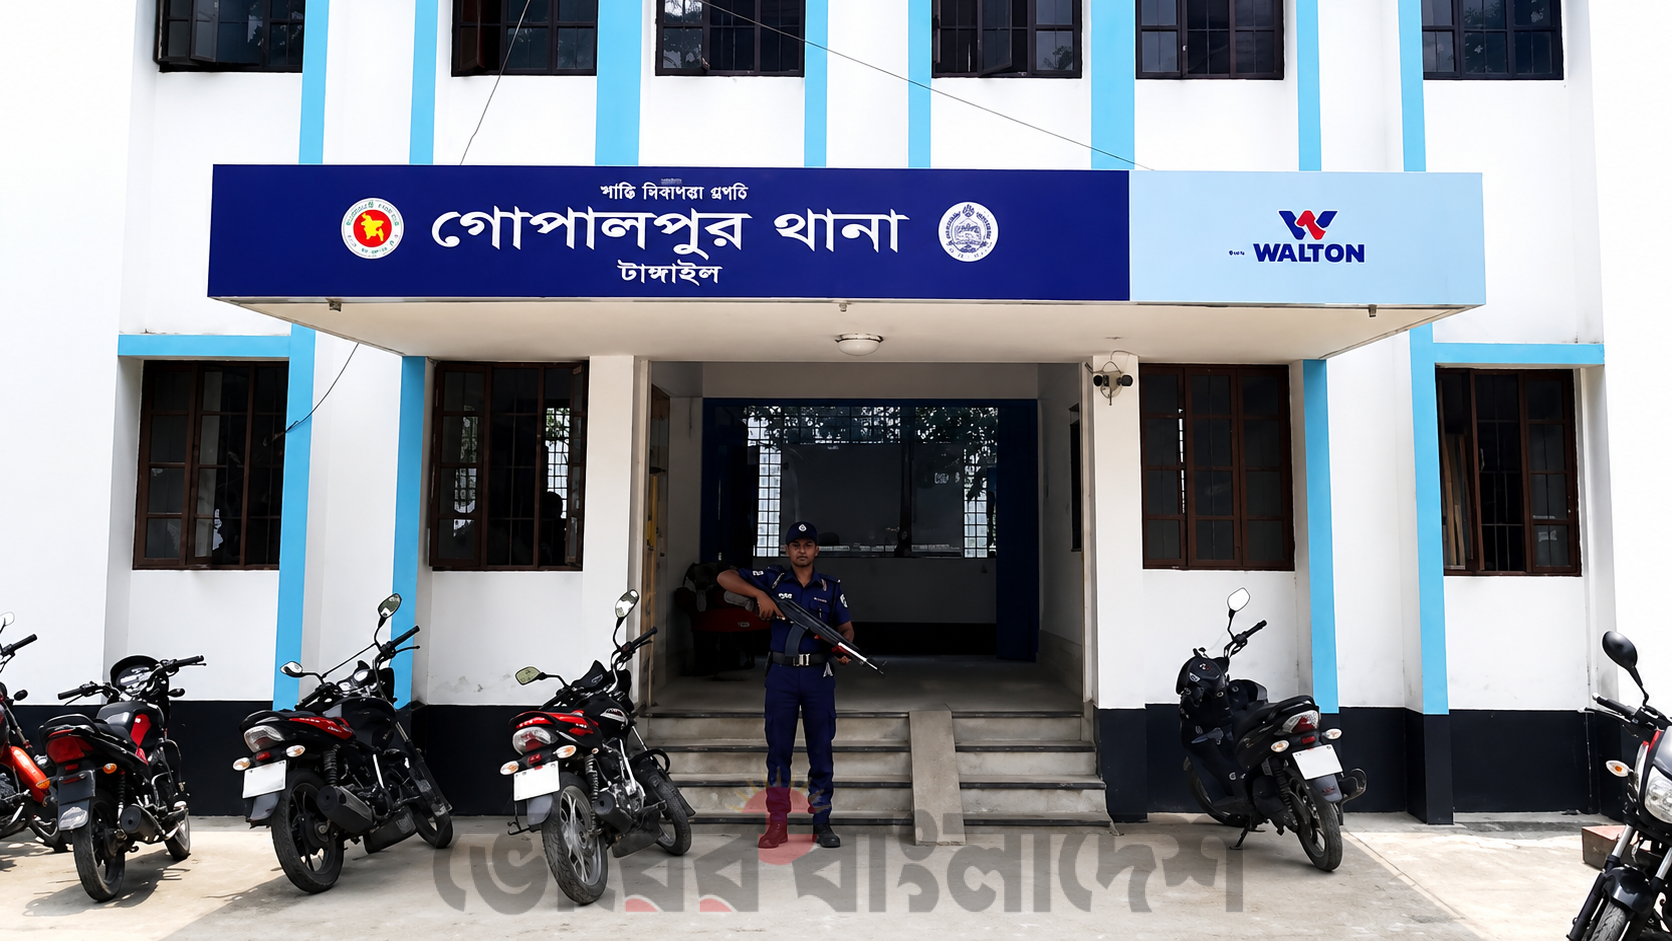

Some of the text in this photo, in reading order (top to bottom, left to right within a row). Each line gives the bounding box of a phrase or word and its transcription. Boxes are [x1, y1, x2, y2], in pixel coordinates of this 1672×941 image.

[431, 205, 753, 260] গোপালপুর
[773, 208, 910, 253] থানা
[1253, 243, 1365, 263] WALTON
[616, 259, 723, 286] টাঙ্গাইল
